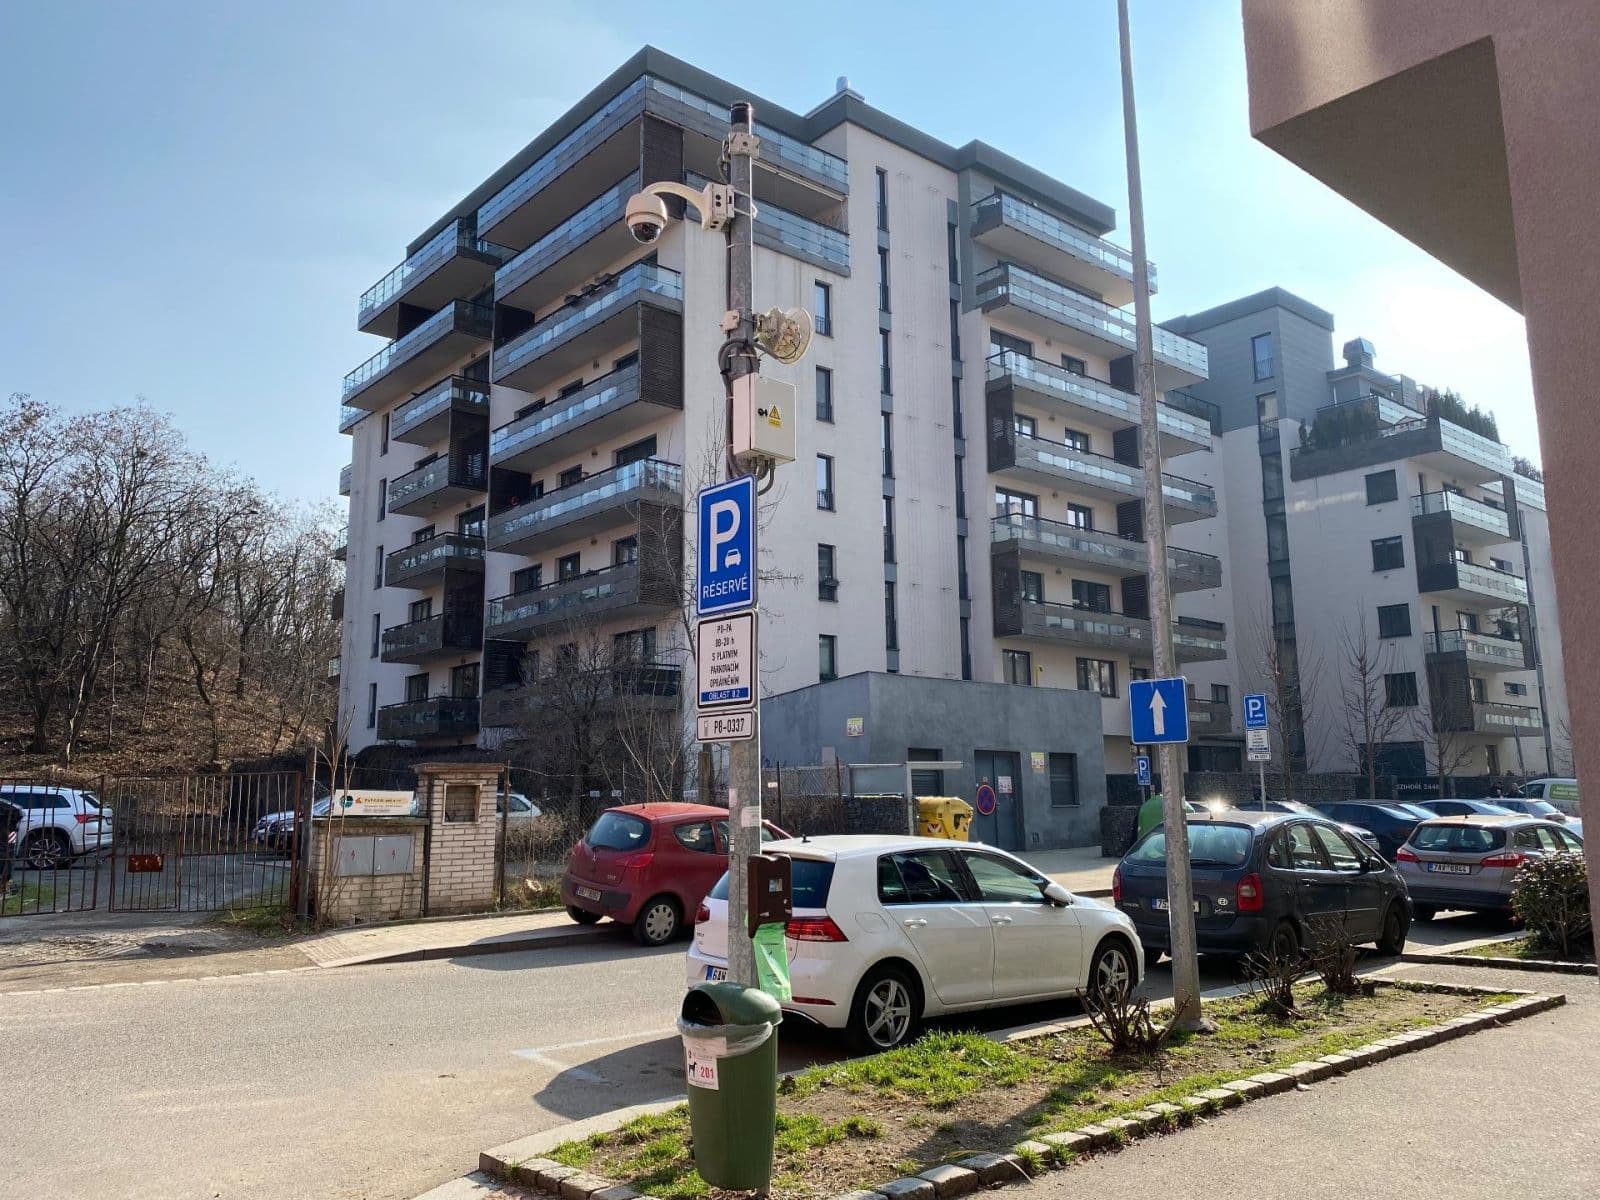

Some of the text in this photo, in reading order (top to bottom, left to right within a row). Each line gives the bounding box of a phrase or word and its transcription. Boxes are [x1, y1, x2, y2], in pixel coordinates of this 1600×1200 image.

[710, 499, 740, 573] P
[703, 573, 748, 599] RÉSERVÉ
[711, 652, 716, 661] S
[708, 690, 730, 701] OBLAST
[1248, 699, 1261, 718] P
[713, 718, 745, 734] P8-0337
[700, 1066, 714, 1079] 201
